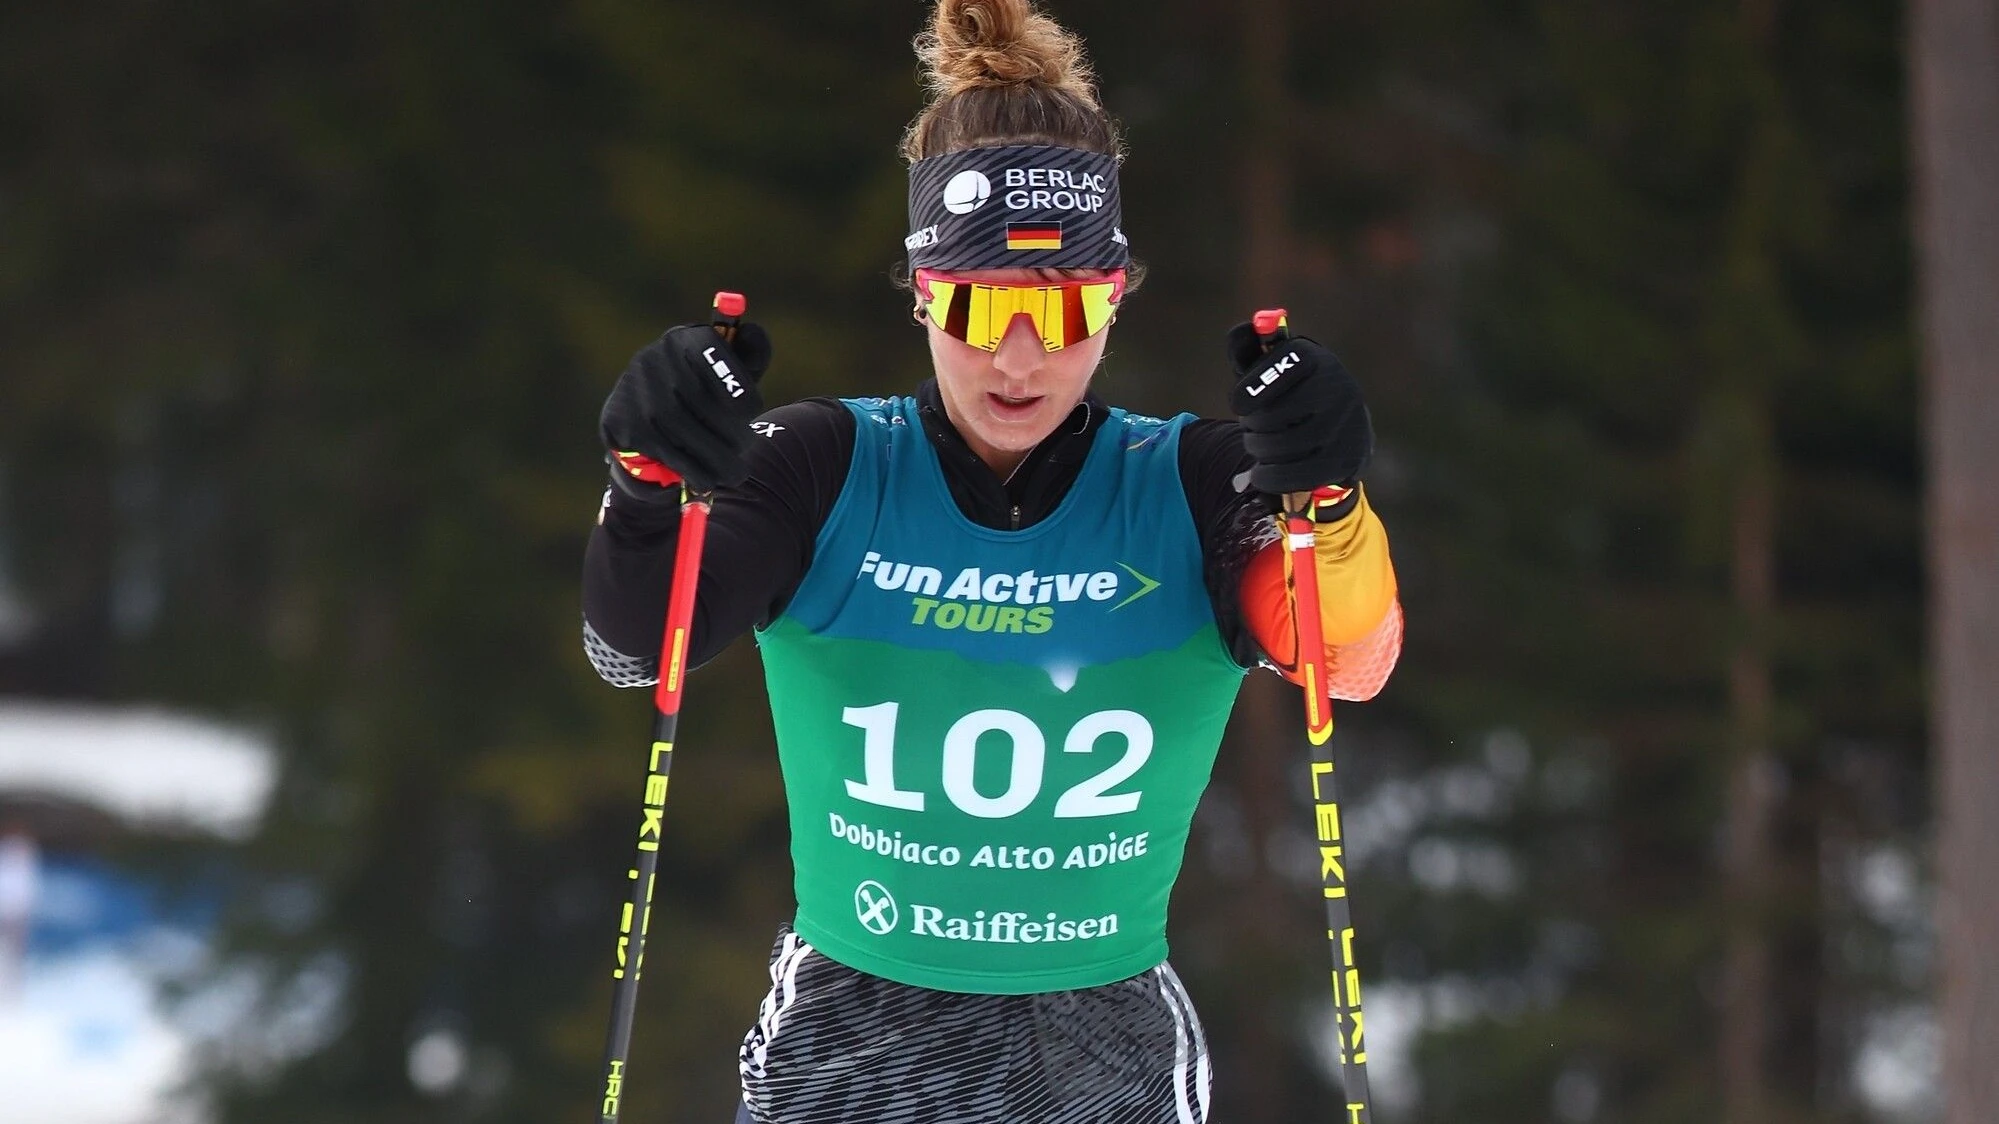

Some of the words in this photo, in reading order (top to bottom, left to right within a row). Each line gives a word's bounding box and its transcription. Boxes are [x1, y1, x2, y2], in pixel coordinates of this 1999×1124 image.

[1005, 168, 1106, 193] BERLAC
[1005, 190, 1103, 213] GROUP
[702, 346, 745, 398] LEKI
[1245, 351, 1300, 397] LEKI
[857, 551, 943, 596] Fun
[943, 567, 1118, 605] Active
[911, 597, 1055, 634] TOURS
[841, 701, 1154, 819] 102
[637, 741, 673, 851] LEKI
[829, 812, 961, 867] Dobbiaco
[1311, 762, 1346, 898] LEKI
[910, 904, 1119, 944] Raiffeisen
[602, 1060, 624, 1118] HRC
